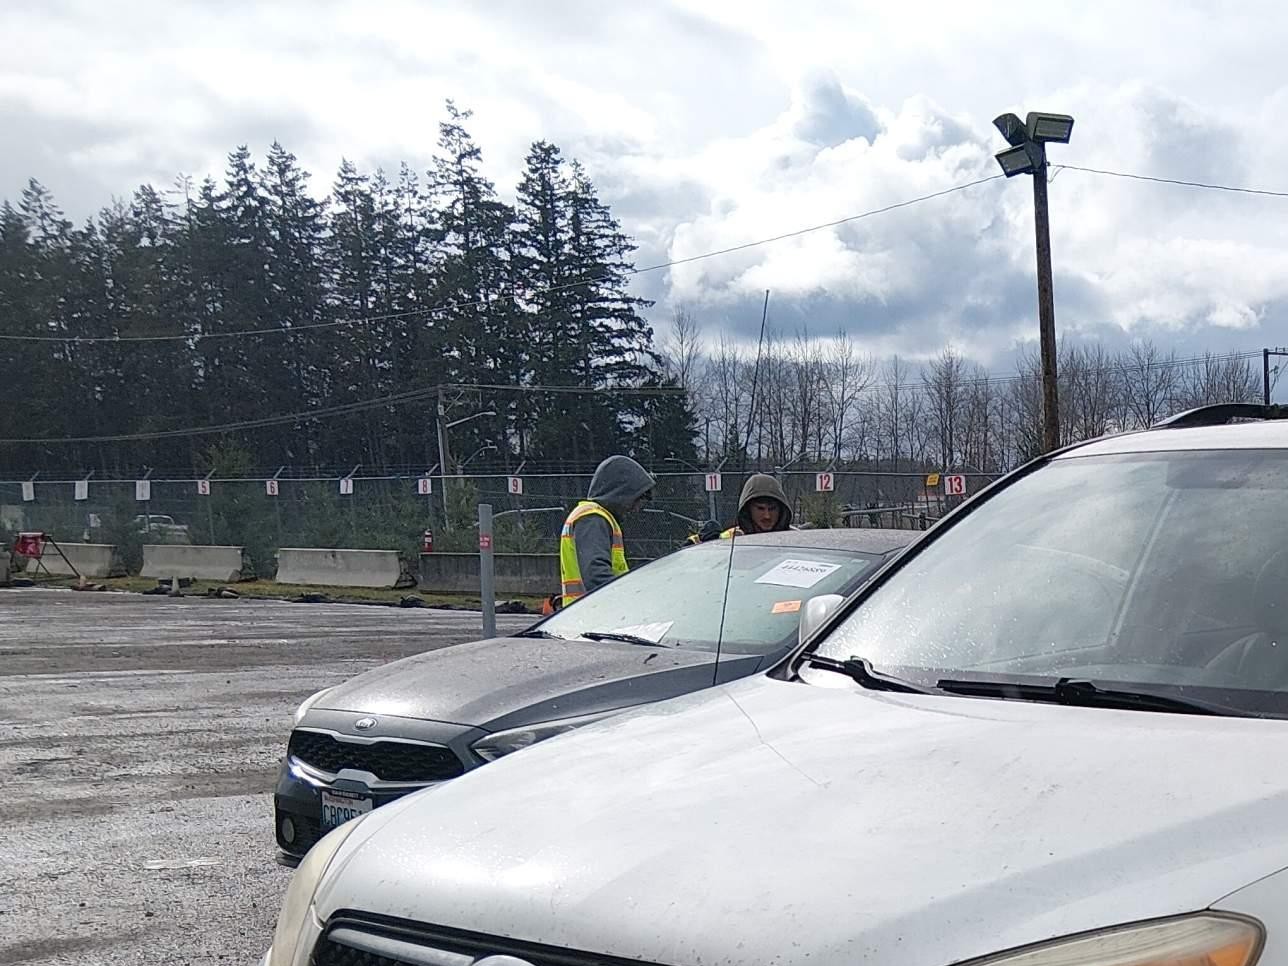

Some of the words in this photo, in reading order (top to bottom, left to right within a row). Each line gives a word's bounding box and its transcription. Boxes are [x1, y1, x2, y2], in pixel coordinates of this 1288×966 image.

[201, 481, 207, 494] 5
[270, 481, 276, 494] 6
[344, 479, 350, 493] 7
[422, 479, 428, 493] 8
[512, 478, 519, 493] 9
[709, 475, 718, 490] 11
[818, 474, 831, 490] 12
[947, 476, 963, 494] 13
